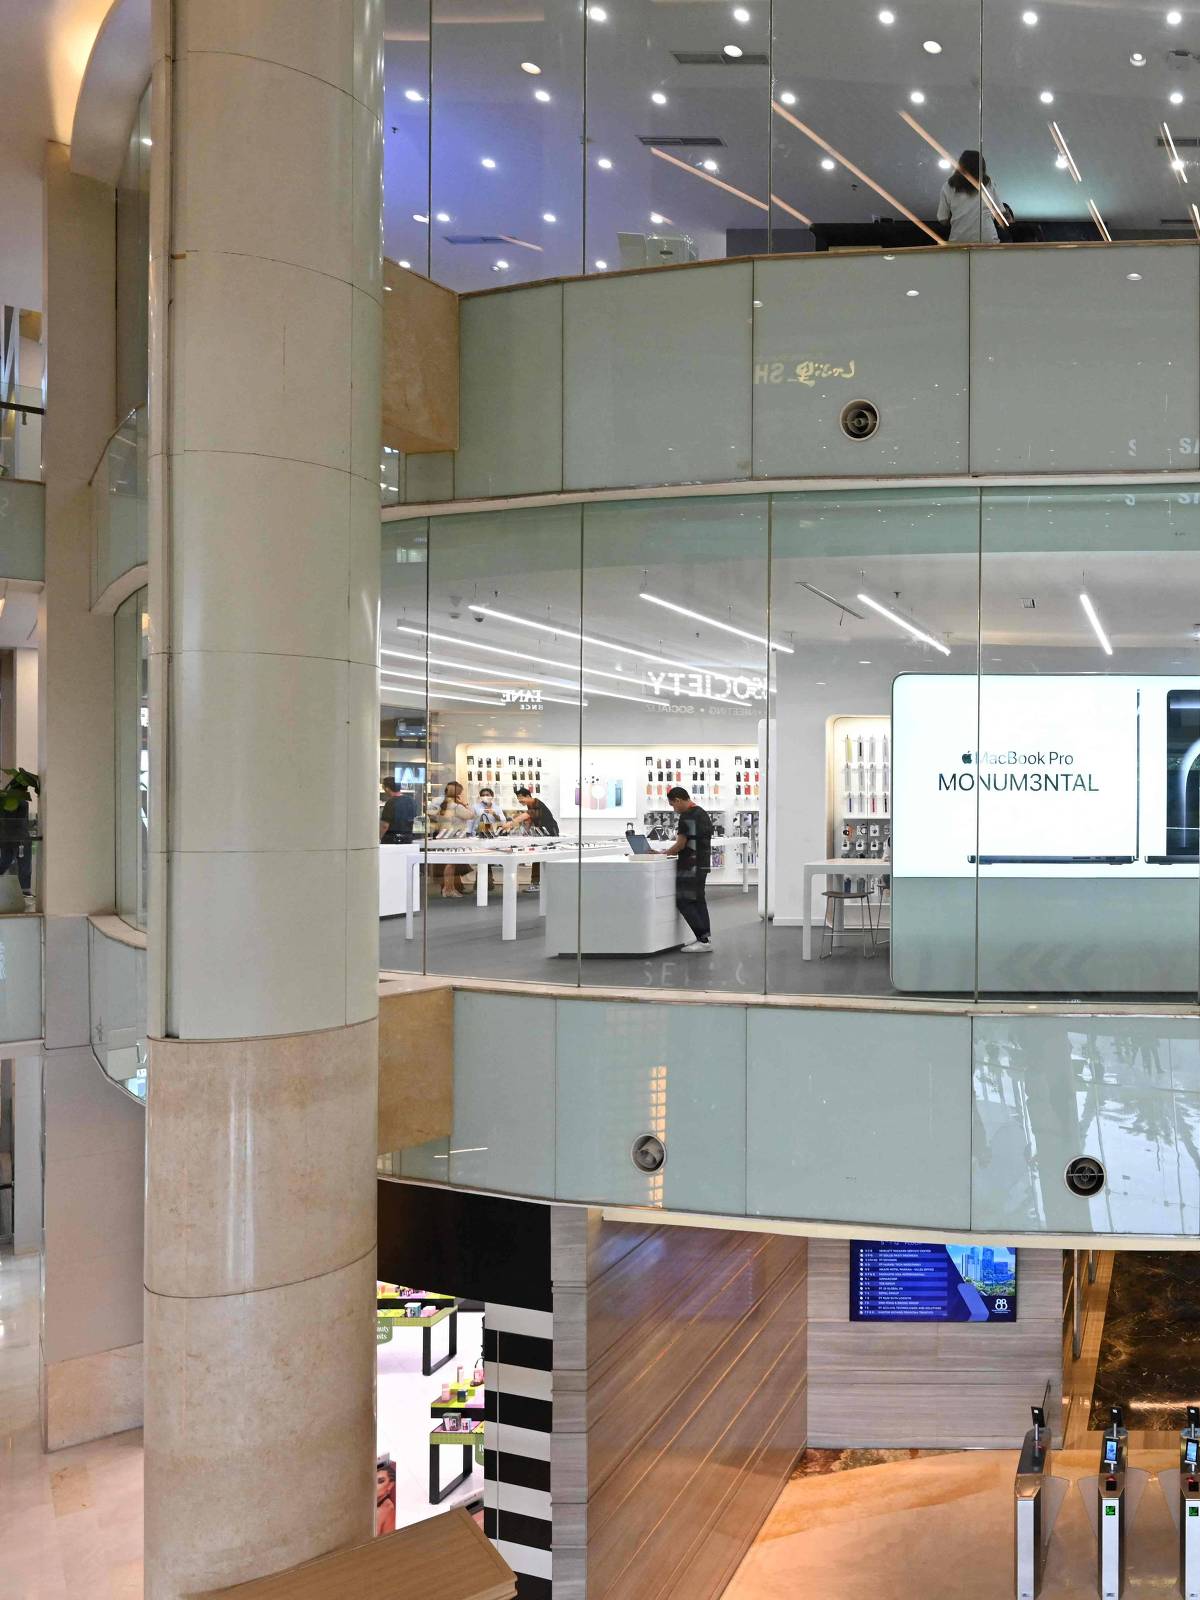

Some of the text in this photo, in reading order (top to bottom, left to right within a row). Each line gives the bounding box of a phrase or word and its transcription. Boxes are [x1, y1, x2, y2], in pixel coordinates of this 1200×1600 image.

[975, 751, 1074, 765] MacBook Pro
[938, 773, 1100, 792] MONUM3NTAL
